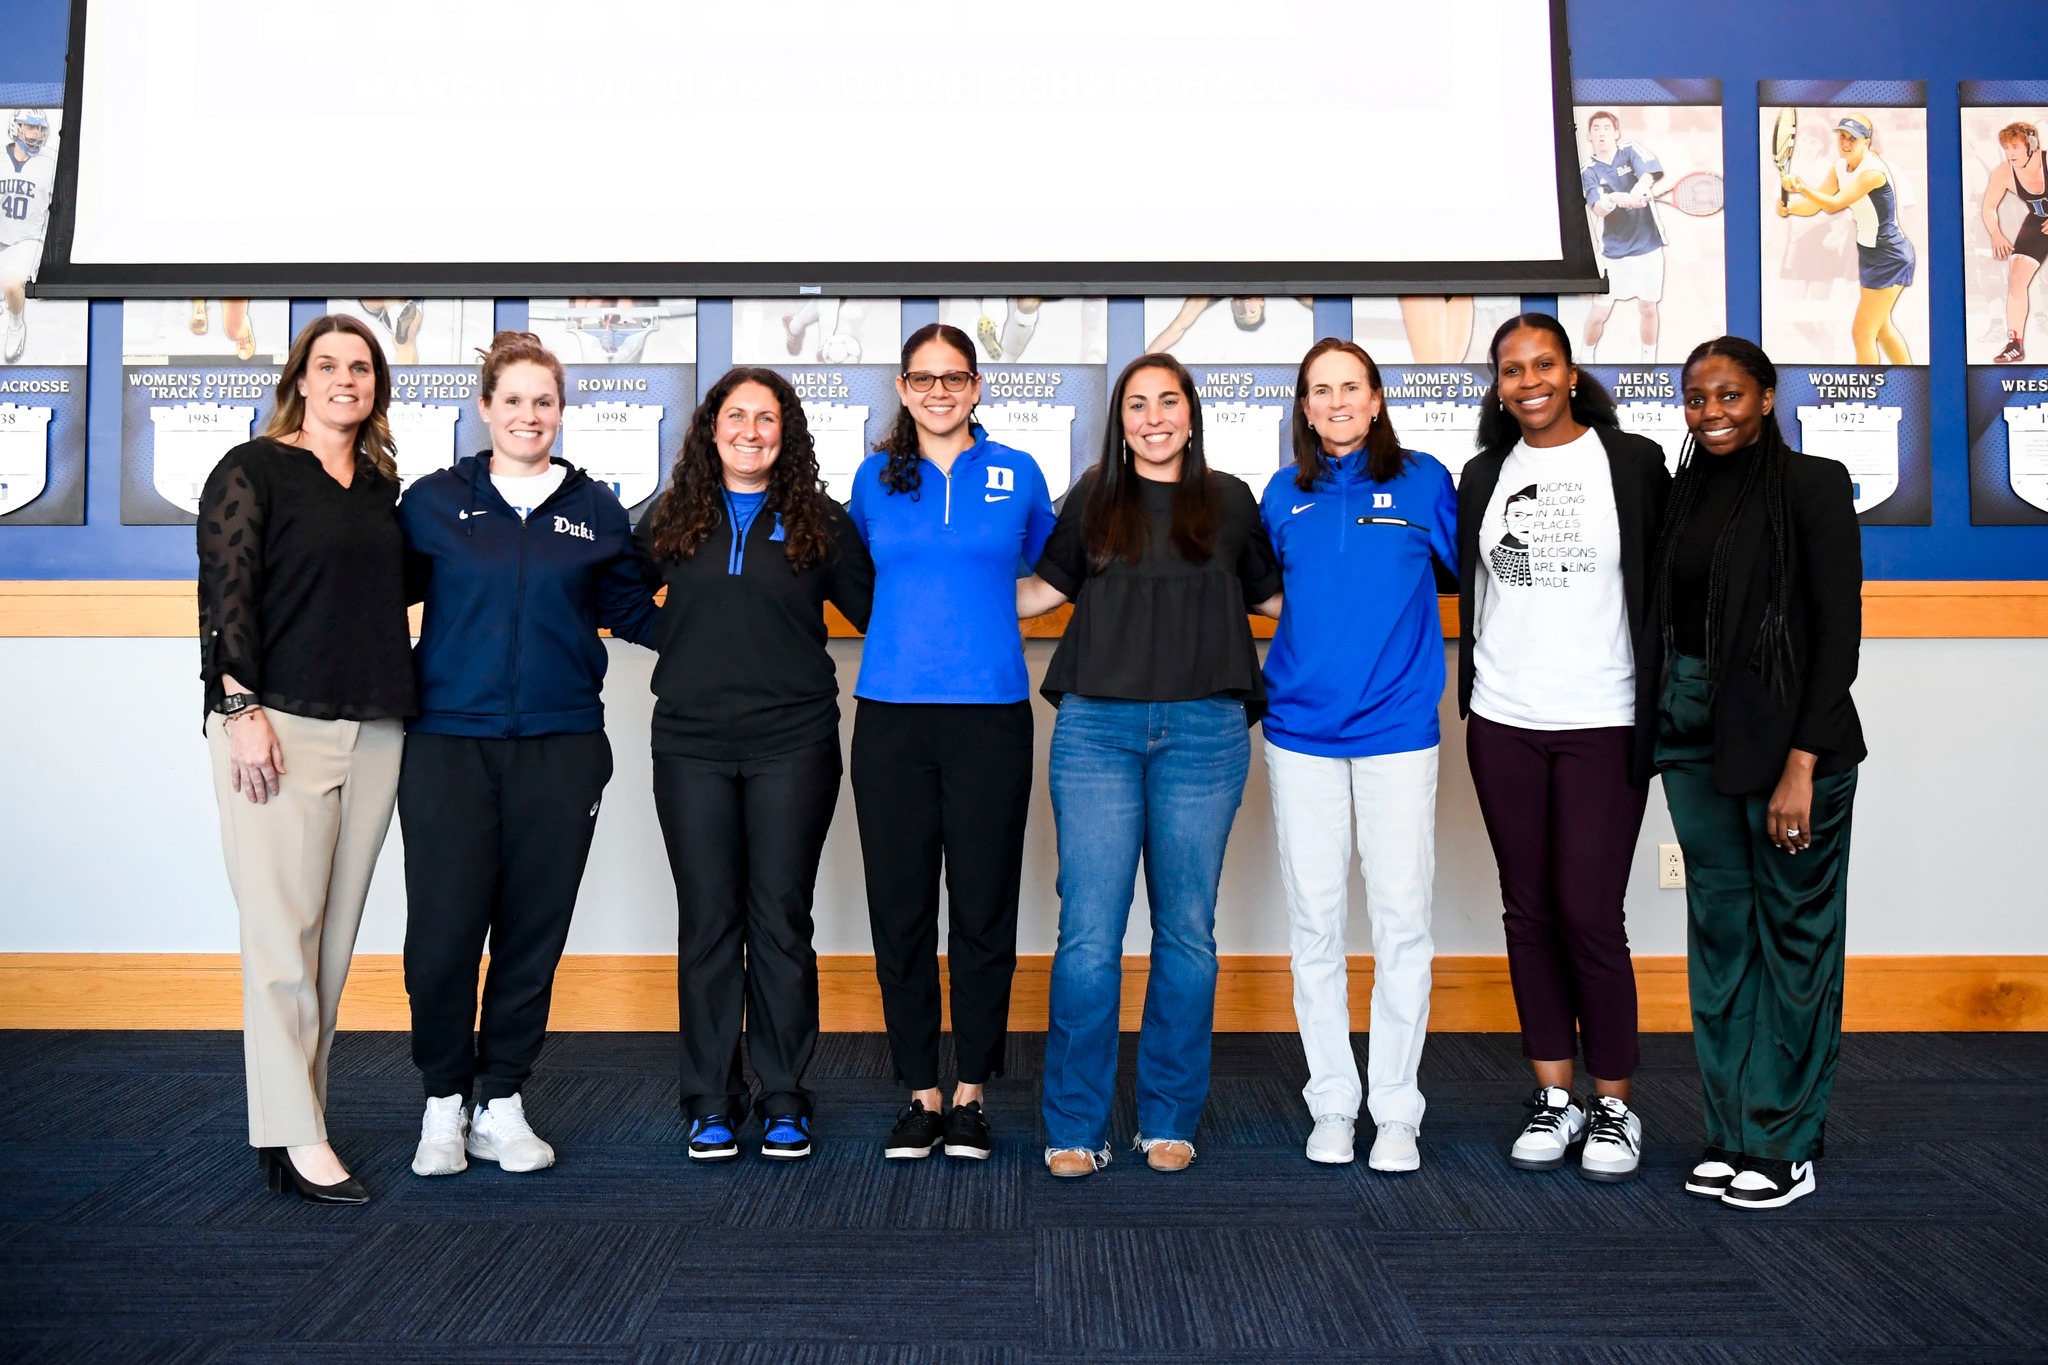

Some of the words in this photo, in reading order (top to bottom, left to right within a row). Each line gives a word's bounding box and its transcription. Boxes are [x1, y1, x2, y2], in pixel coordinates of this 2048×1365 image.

[0, 178, 36, 198] DUKE
[2, 195, 29, 221] 40
[128, 373, 201, 386] WOMEN'S
[205, 373, 282, 386] OUTDOOR
[397, 373, 478, 386] OUTDOOR
[578, 378, 648, 392] ROWING
[791, 373, 843, 386] MEN'S
[984, 372, 1062, 385] WOMEN'S
[1206, 372, 1254, 385] MEN'S
[1402, 372, 1474, 385] WOMEN'S
[1618, 372, 1670, 385] MEN'S
[1808, 373, 1885, 386] WOMEN'S
[0, 380, 70, 393] ACROSSE
[795, 386, 849, 398] OCCER
[990, 385, 1056, 398] SOCCER
[1195, 385, 1235, 398] MING
[1238, 385, 1251, 398] &
[1254, 385, 1296, 398] DIVIN
[1384, 385, 1442, 398] IMMING
[1446, 385, 1458, 398] &
[1462, 385, 1490, 398] DIV
[1613, 385, 1675, 398] TENNIS
[2001, 379, 2048, 392] WRES
[148, 386, 198, 399] TRACK
[202, 386, 214, 399] &
[219, 386, 263, 399] FIELD
[406, 386, 418, 399] &
[424, 386, 470, 399] FIELD
[1816, 386, 1878, 399] TENNIS
[0, 413, 16, 424] 38
[187, 413, 218, 424] 1984
[596, 412, 628, 424] 1998
[806, 412, 833, 424] 935
[1007, 412, 1040, 424] 1988
[1215, 412, 1247, 424] 1927
[1425, 412, 1455, 423] 1971
[1631, 412, 1662, 423] 1954
[1834, 413, 1865, 424] 1972
[1539, 482, 1583, 493] WOMEN
[1537, 495, 1586, 507] BELONG
[1535, 509, 1548, 518] IN
[1552, 508, 1580, 517] ALL
[1533, 519, 1581, 530] PLACES
[1532, 532, 1583, 543] WHERE
[1531, 547, 1598, 558] DECISIONS
[1533, 562, 1556, 573] ARE
[1561, 562, 1596, 573] BEING
[1534, 577, 1570, 588] MADE
